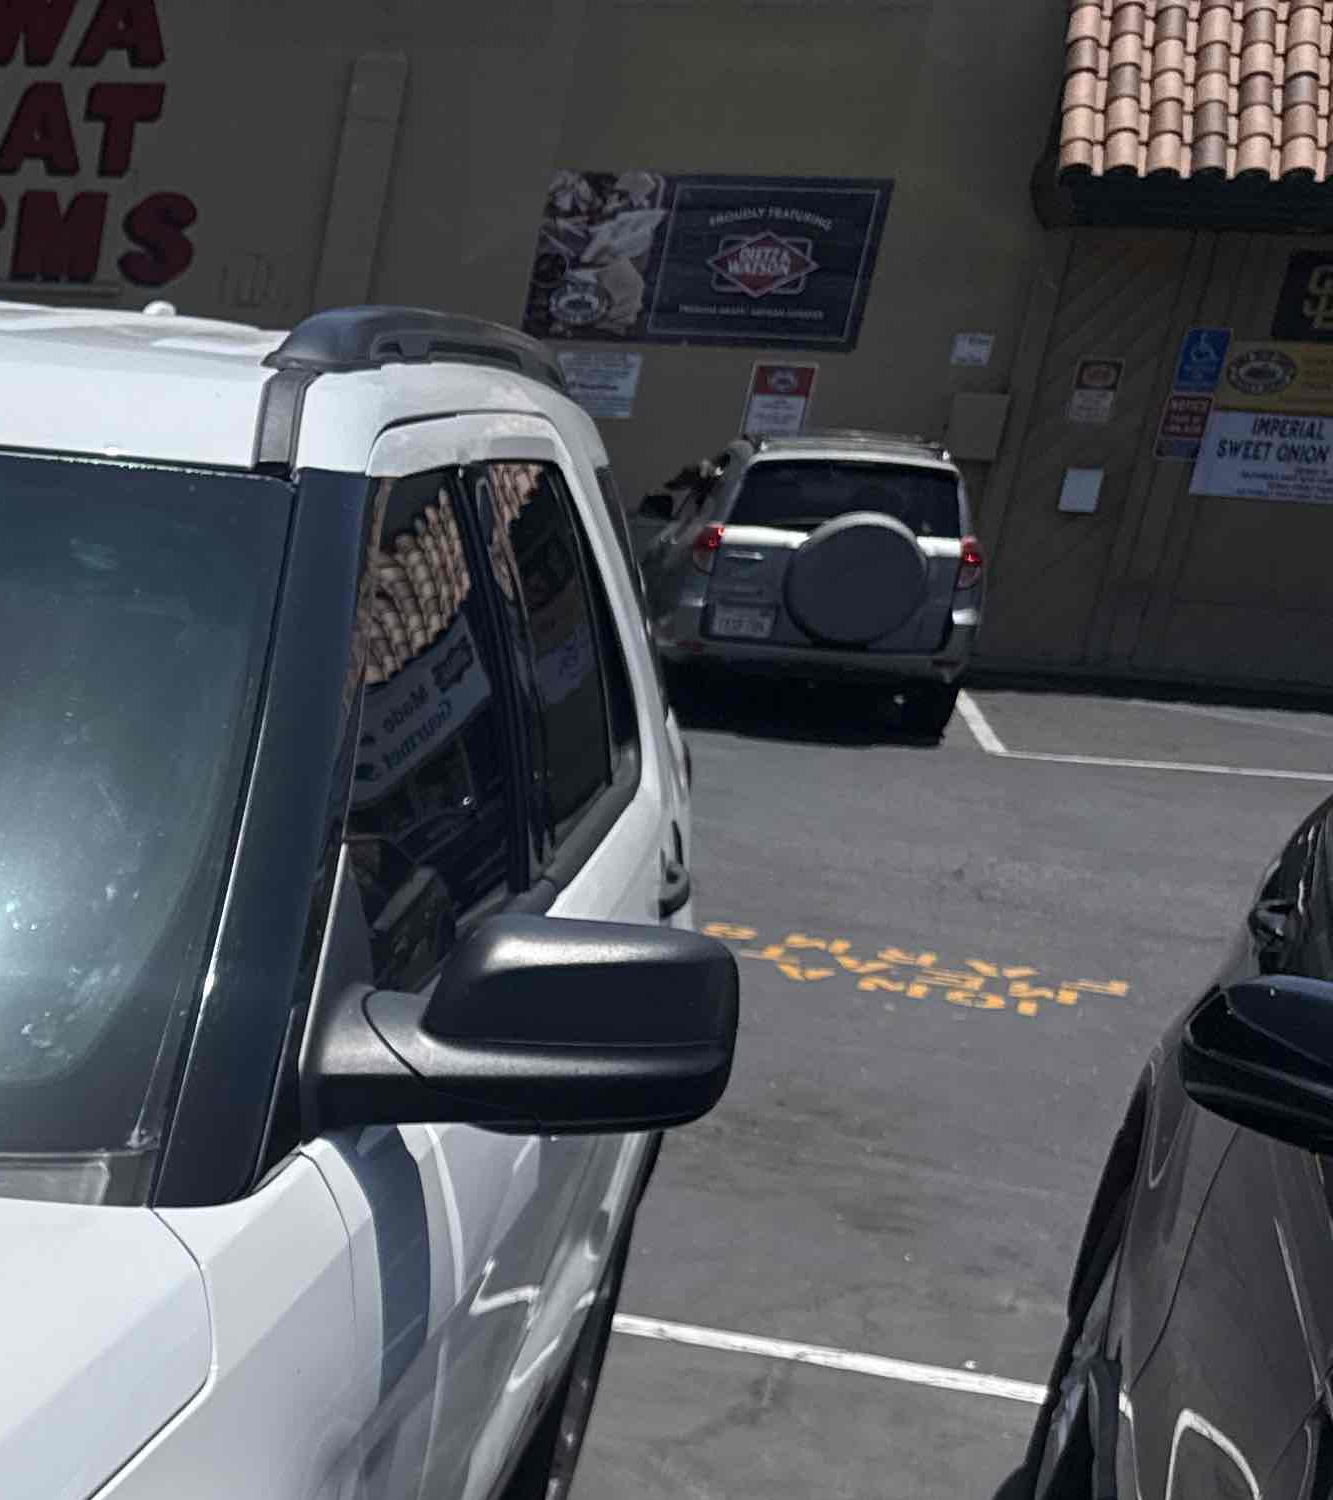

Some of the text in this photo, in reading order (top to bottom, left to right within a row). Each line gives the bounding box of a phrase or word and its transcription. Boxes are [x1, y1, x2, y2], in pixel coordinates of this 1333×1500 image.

[1252, 416, 1326, 441] IMPERIAL
[1216, 438, 1330, 465] SWEET ONION
